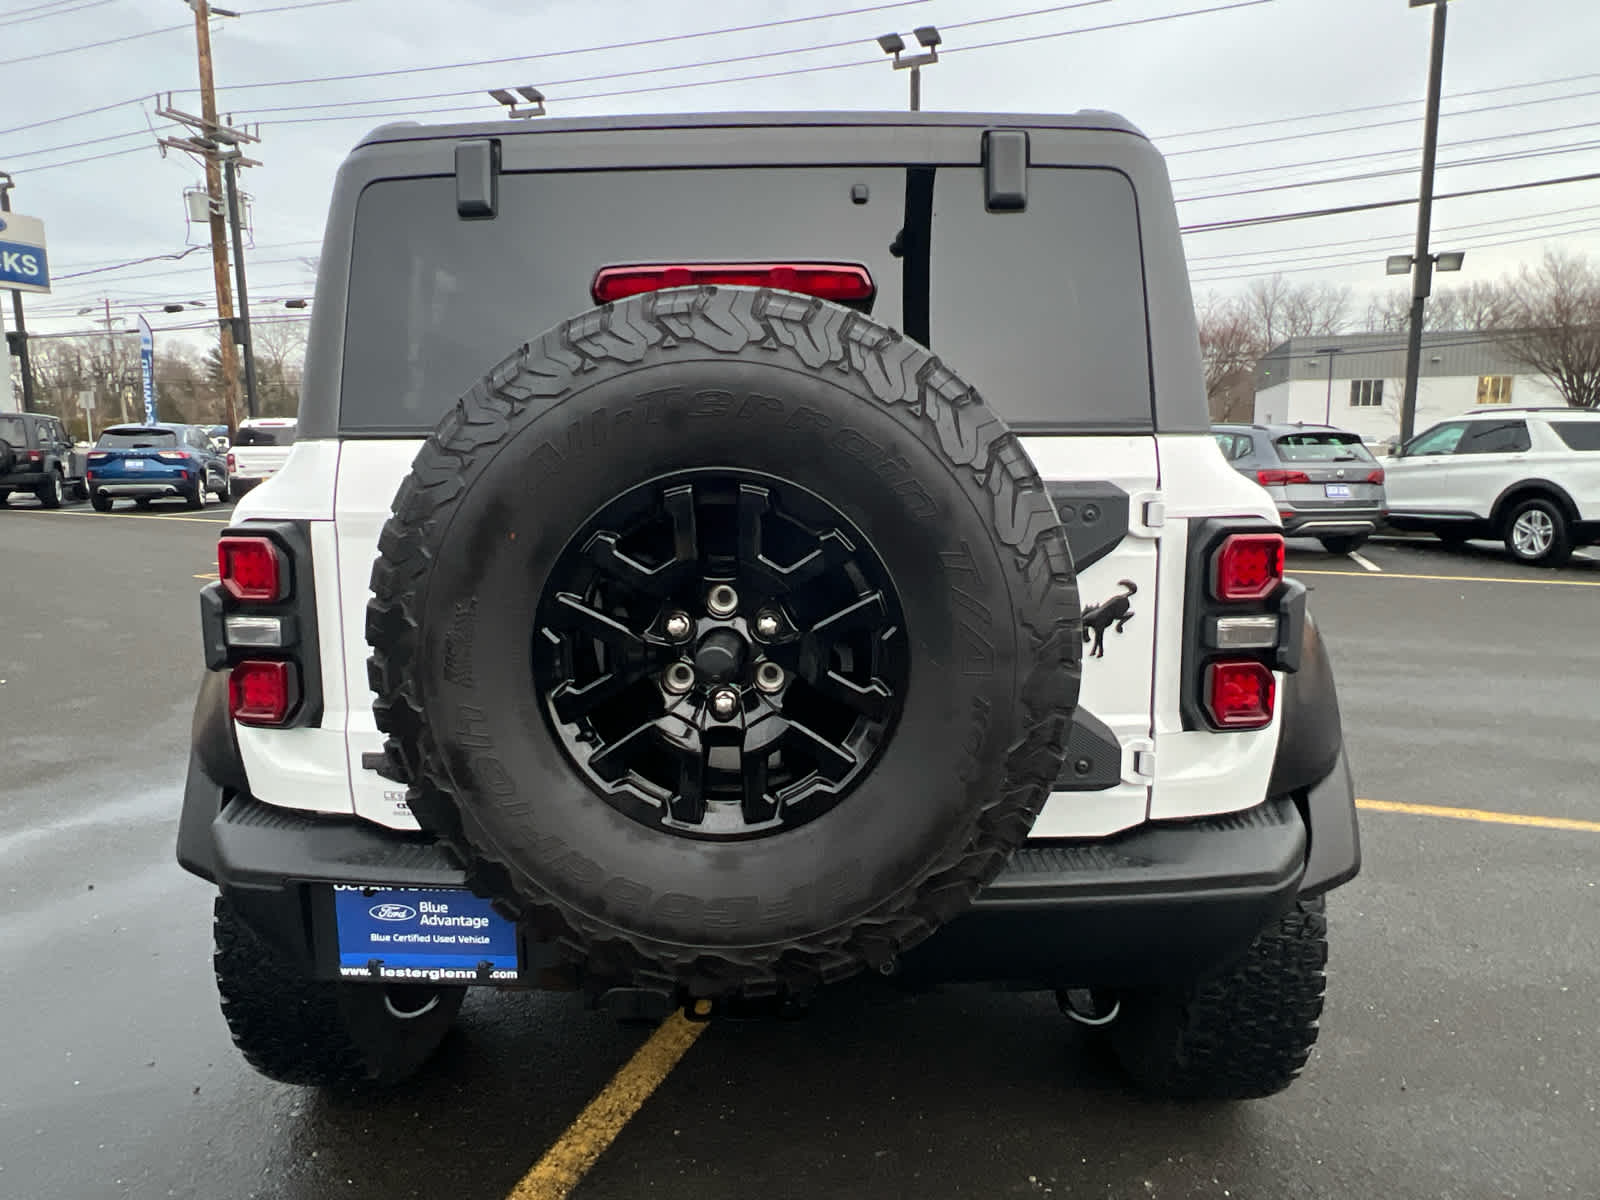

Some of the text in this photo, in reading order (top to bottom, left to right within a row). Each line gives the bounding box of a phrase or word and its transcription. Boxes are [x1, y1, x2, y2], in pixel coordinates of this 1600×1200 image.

[0, 250, 39, 276] KS
[419, 901, 449, 914] Blue
[419, 914, 489, 929] Advantage
[370, 933, 490, 944] Blue Certified Used Vehicle
[340, 967, 518, 980] www. lesterglenn .com
